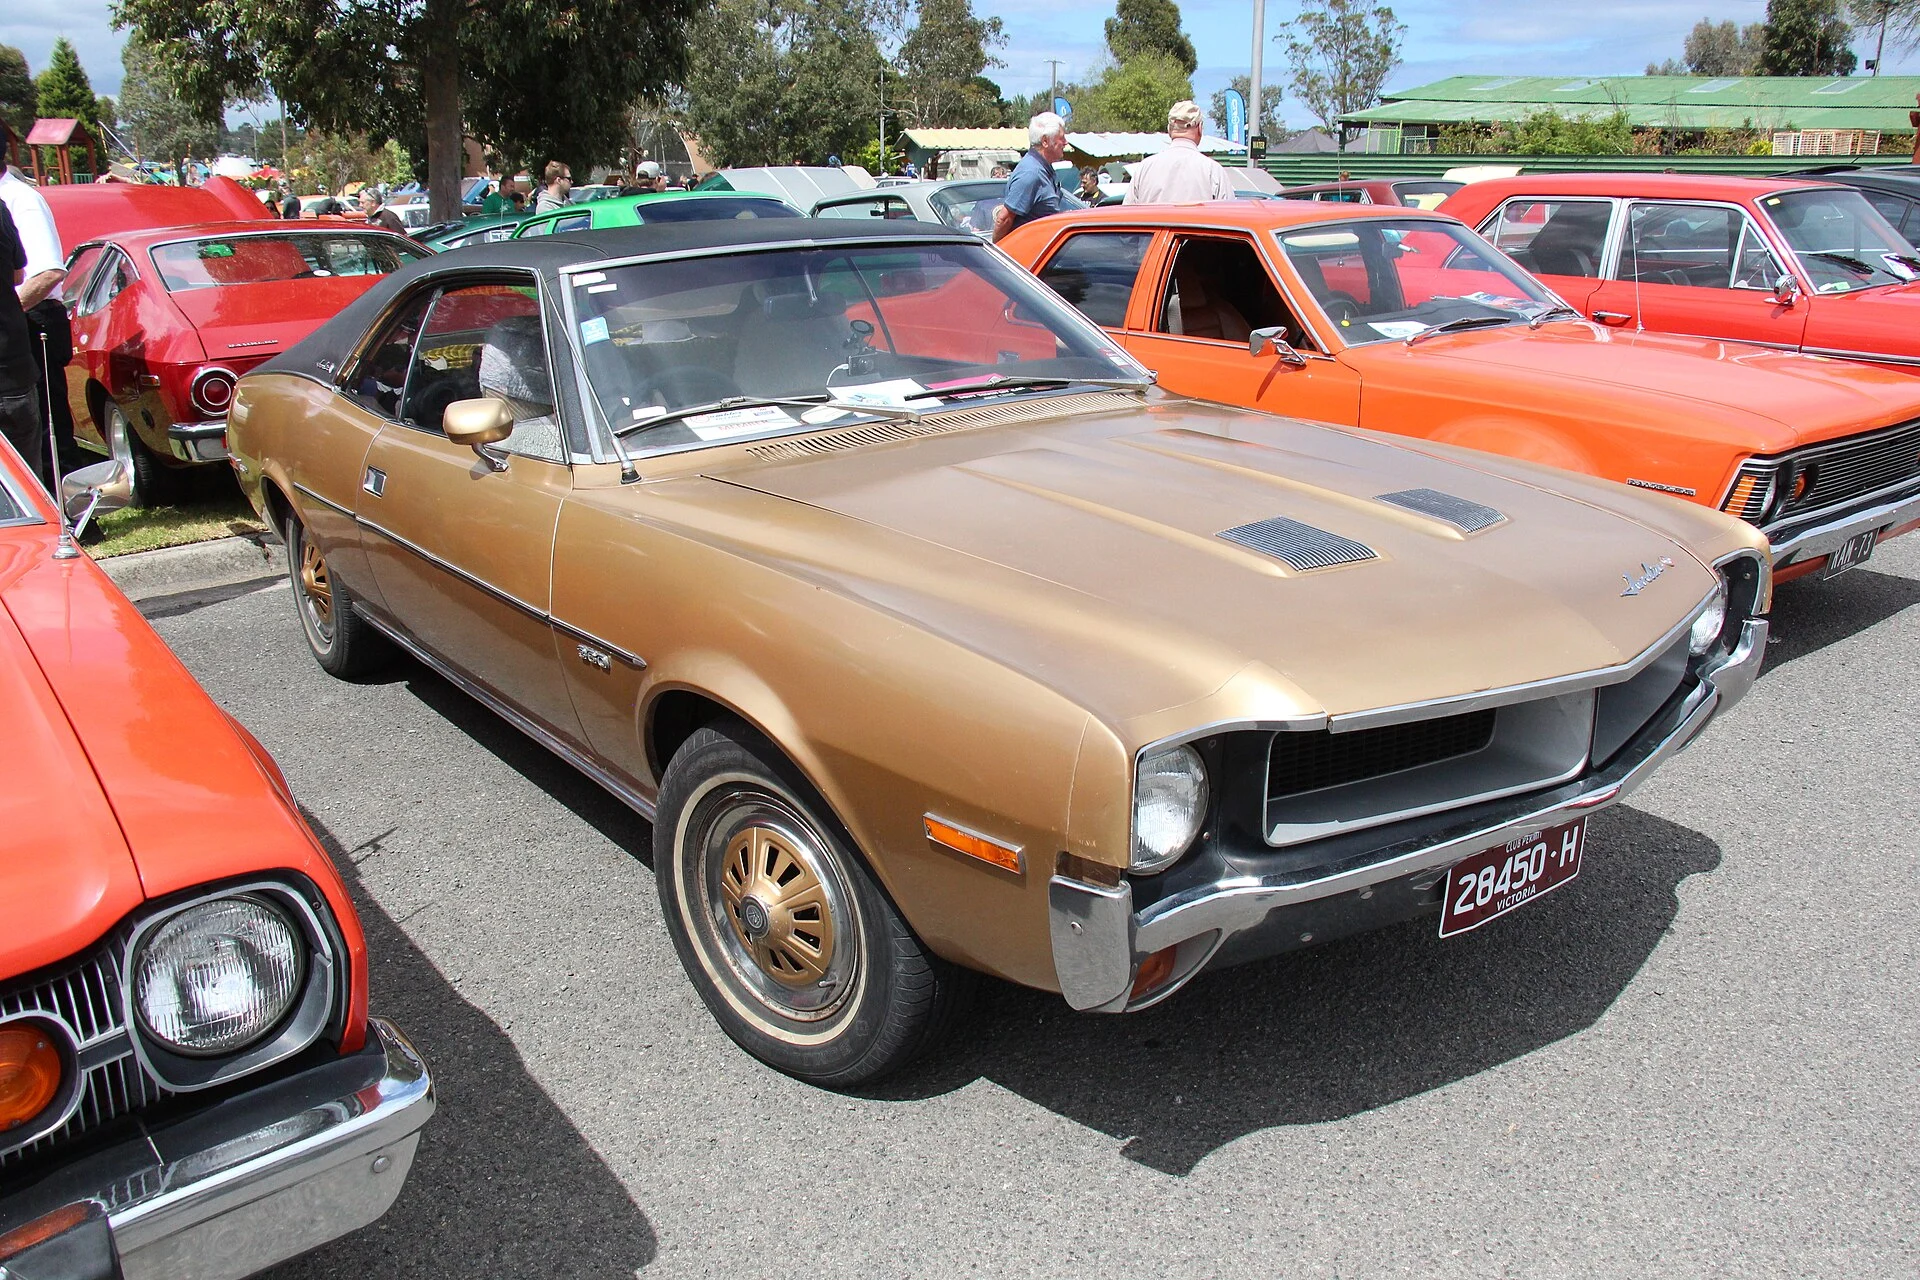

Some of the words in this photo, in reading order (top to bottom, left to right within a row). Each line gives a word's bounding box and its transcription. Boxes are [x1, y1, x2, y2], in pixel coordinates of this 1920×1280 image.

[576, 644, 611, 669] 360
[1505, 839, 1522, 853] CLUB
[1496, 883, 1536, 911] VICTORIA
